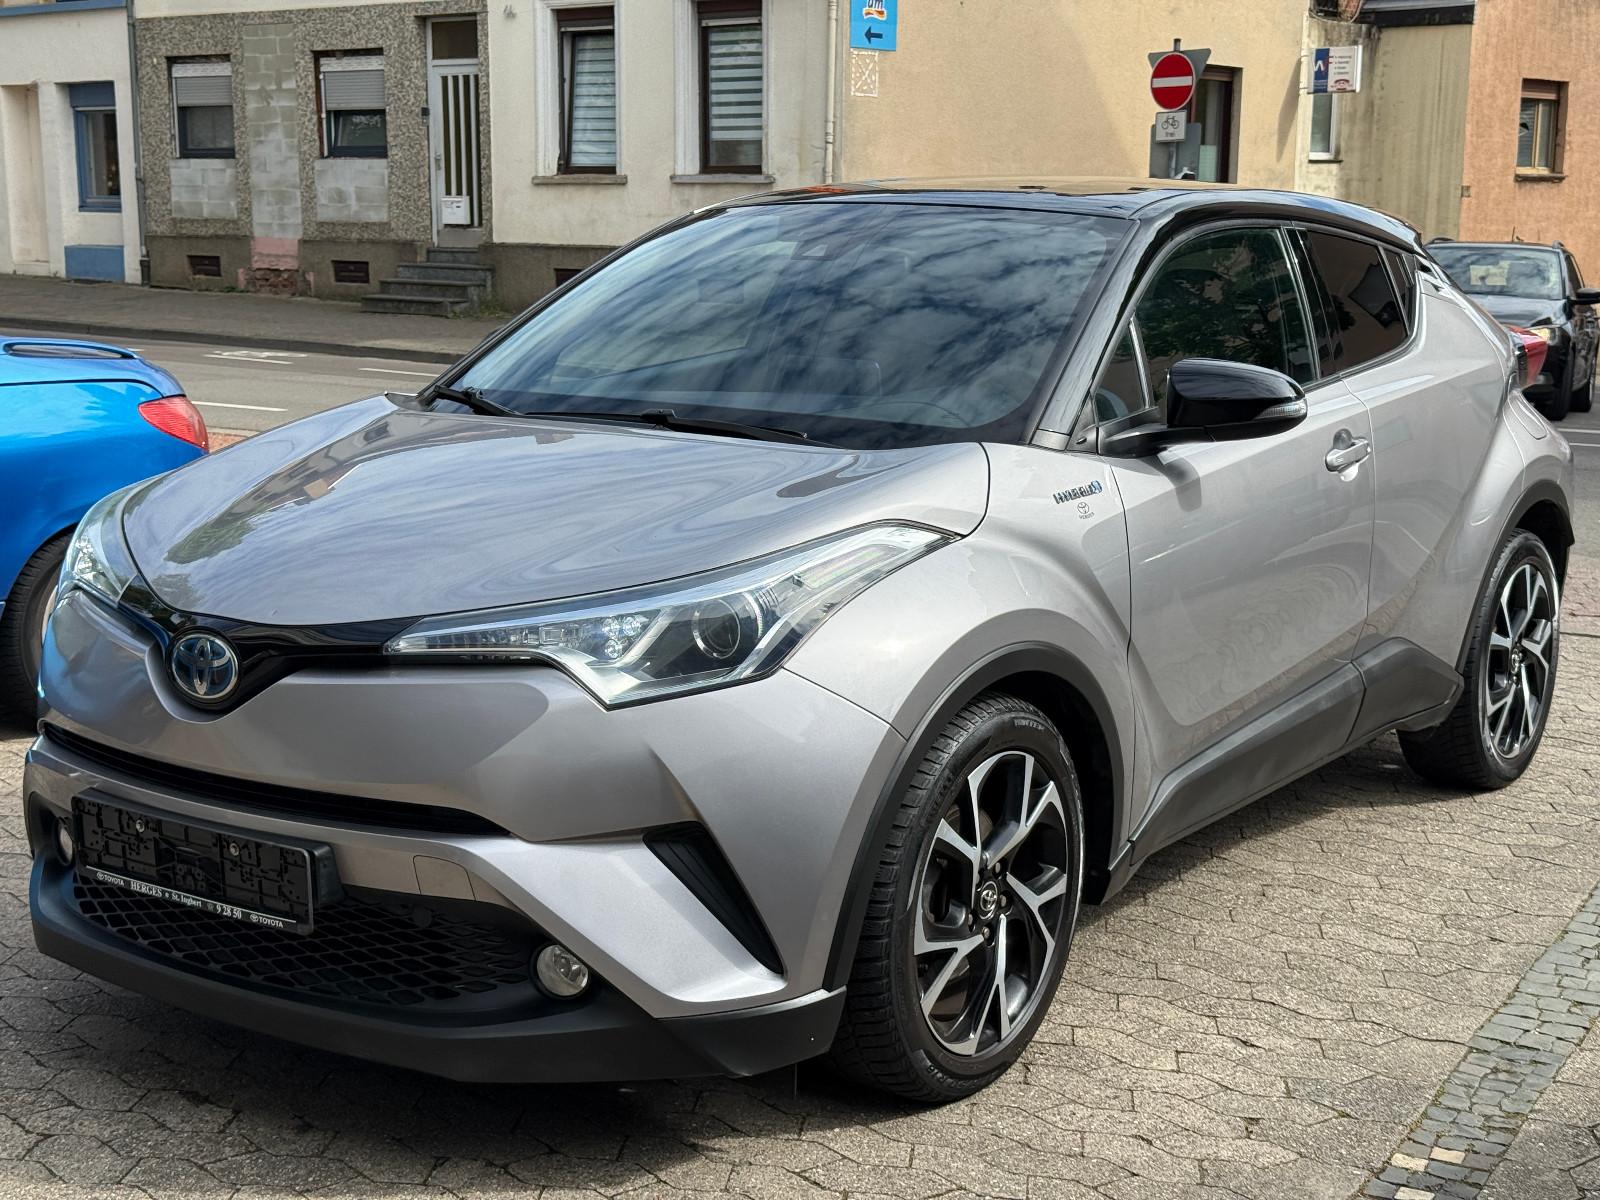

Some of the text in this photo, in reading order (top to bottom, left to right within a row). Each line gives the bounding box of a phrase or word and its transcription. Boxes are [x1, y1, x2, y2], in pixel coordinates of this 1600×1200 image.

[103, 874, 125, 886] TOYOTA
[130, 880, 163, 897] HERGES
[222, 905, 232, 917] 28
[232, 908, 242, 920] 50
[258, 915, 284, 929] TOYOTA
